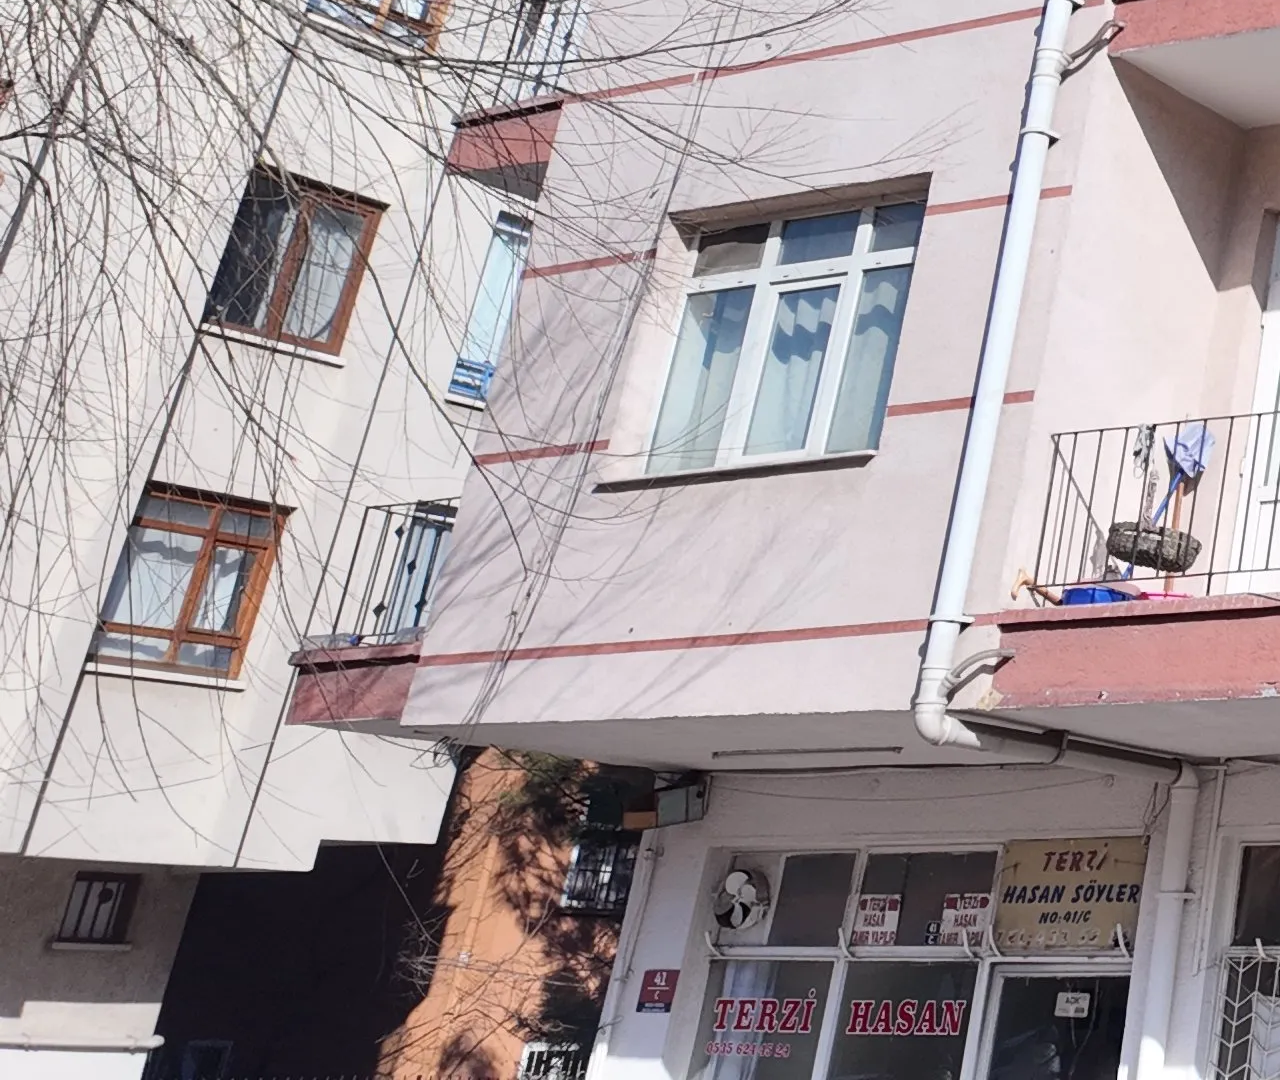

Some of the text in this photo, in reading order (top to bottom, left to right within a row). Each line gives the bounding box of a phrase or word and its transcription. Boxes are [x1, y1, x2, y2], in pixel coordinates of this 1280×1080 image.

[1002, 879, 1140, 904] HASAN SÖYLER
[654, 971, 667, 986] 41
[713, 988, 967, 1036] TERZİ HASAN
